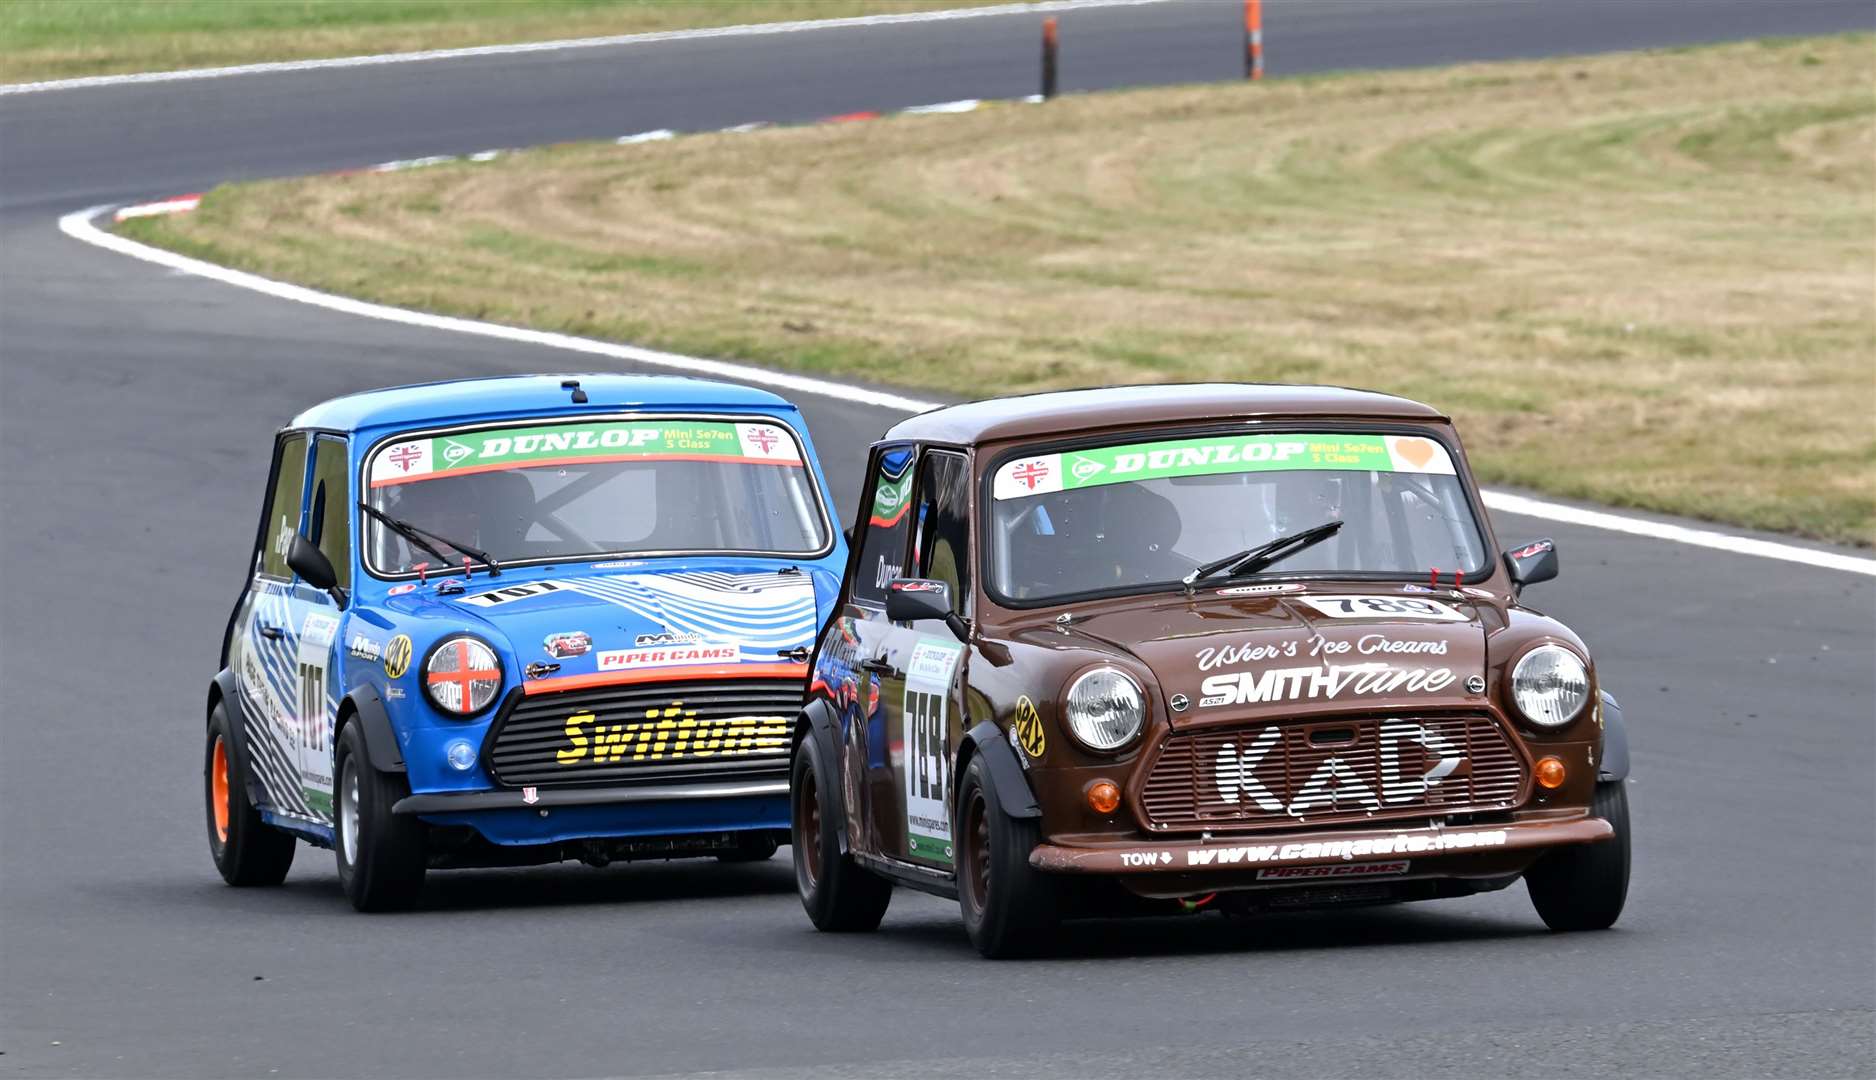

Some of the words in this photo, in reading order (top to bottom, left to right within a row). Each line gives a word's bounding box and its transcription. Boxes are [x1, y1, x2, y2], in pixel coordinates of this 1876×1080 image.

[478, 429, 658, 459] DUNLOP
[664, 429, 693, 440] Mini
[697, 429, 733, 440] Se7en
[678, 440, 710, 449] Class
[1110, 443, 1305, 474] DUNLOP
[1309, 443, 1340, 453] Mini
[1324, 454, 1360, 464] Class
[469, 582, 559, 603] 707
[1315, 598, 1444, 615] 789
[603, 651, 665, 666] PIPER
[670, 648, 736, 661] CAMS
[1196, 641, 1298, 670] Usher's
[1307, 634, 1351, 656] Ice
[1357, 634, 1449, 655] Creams
[299, 662, 323, 752] 707
[556, 701, 787, 765] Swiftune
[1017, 701, 1043, 754] SPAX
[906, 690, 944, 801] 789
[1215, 717, 1467, 817] KAD
[1120, 852, 1158, 866] TOW
[1262, 867, 1329, 878] PIPER
[1332, 862, 1407, 875] CAMS
